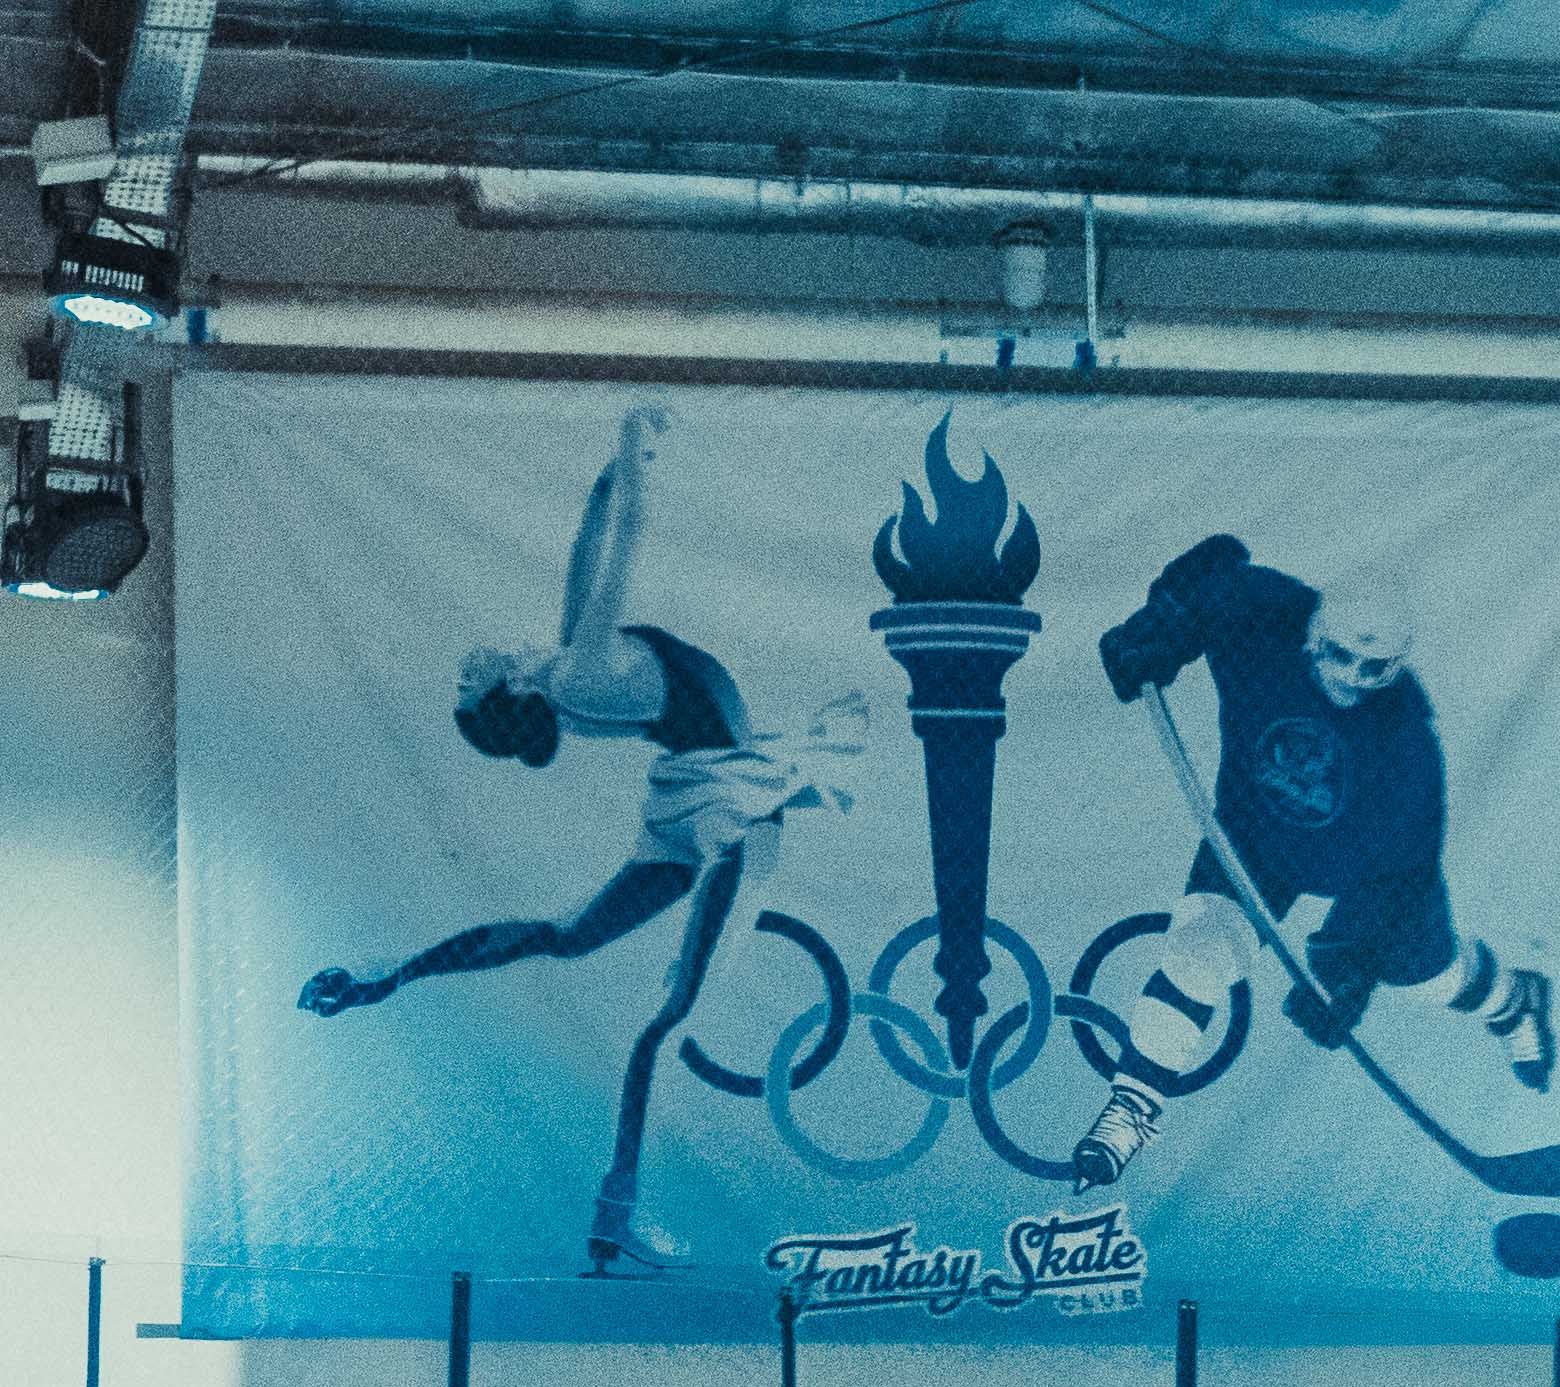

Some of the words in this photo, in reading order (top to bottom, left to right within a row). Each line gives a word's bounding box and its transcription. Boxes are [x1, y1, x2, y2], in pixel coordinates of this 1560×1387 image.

[766, 1224, 980, 1314] Fantasy
[980, 1206, 1144, 1308] Skate
[1059, 1286, 1142, 1315] CLUB
